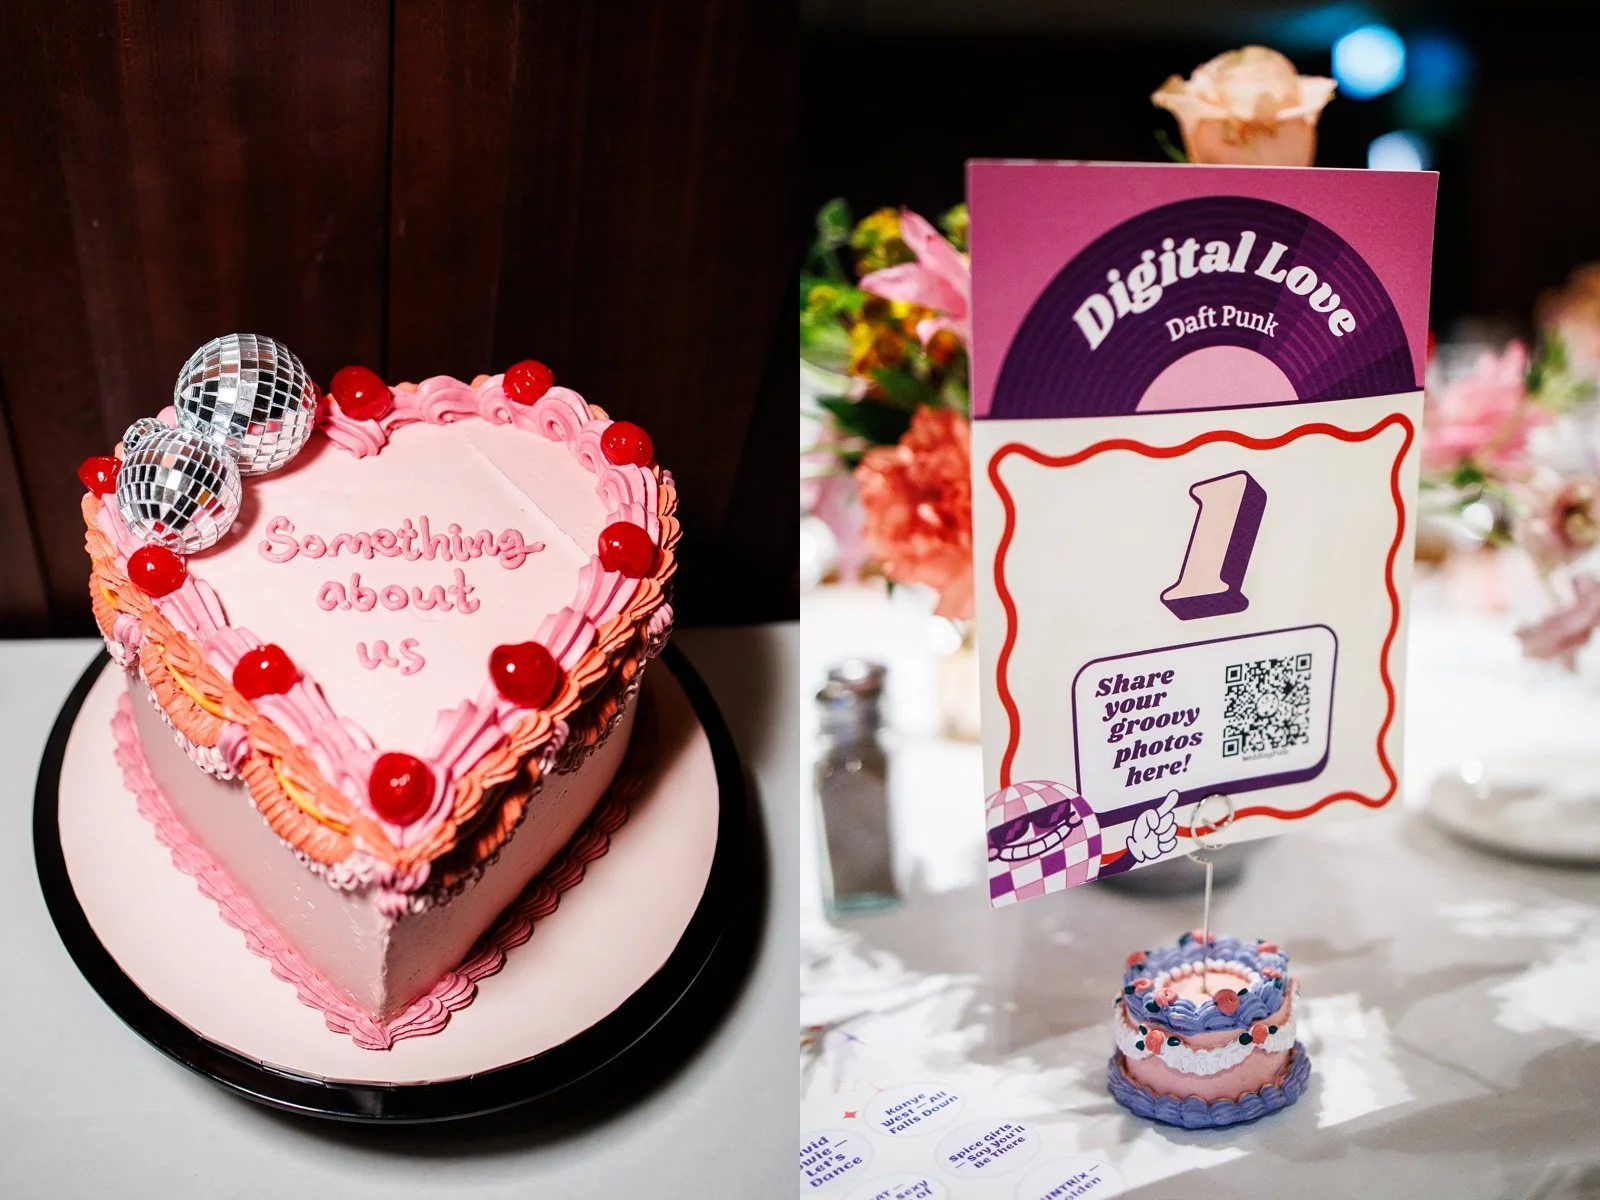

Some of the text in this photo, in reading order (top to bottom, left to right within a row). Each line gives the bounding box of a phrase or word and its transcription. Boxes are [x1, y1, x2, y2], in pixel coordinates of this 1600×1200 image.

[1072, 230, 1356, 351] Digital Love
[1165, 305, 1279, 342] Daft Punk
[258, 515, 546, 570] Something
[1160, 470, 1267, 621] 1
[316, 568, 481, 614] about
[356, 638, 426, 676] us
[1095, 669, 1175, 698] Share
[1102, 691, 1167, 722] your
[1107, 707, 1200, 743] groovy
[1112, 731, 1204, 769] photos
[1124, 753, 1192, 787] here!
[881, 1108, 915, 1128] West
[929, 1090, 947, 1103] All
[885, 1092, 926, 1115] Kanye
[889, 1095, 959, 1135] Falls Down
[948, 1123, 1012, 1162] Spice Girls
[967, 1146, 992, 1162] Say
[990, 1125, 1026, 1148] You'll
[974, 1136, 1026, 1169] Be There
[805, 1153, 846, 1177] Let's
[810, 1156, 863, 1187] Dance
